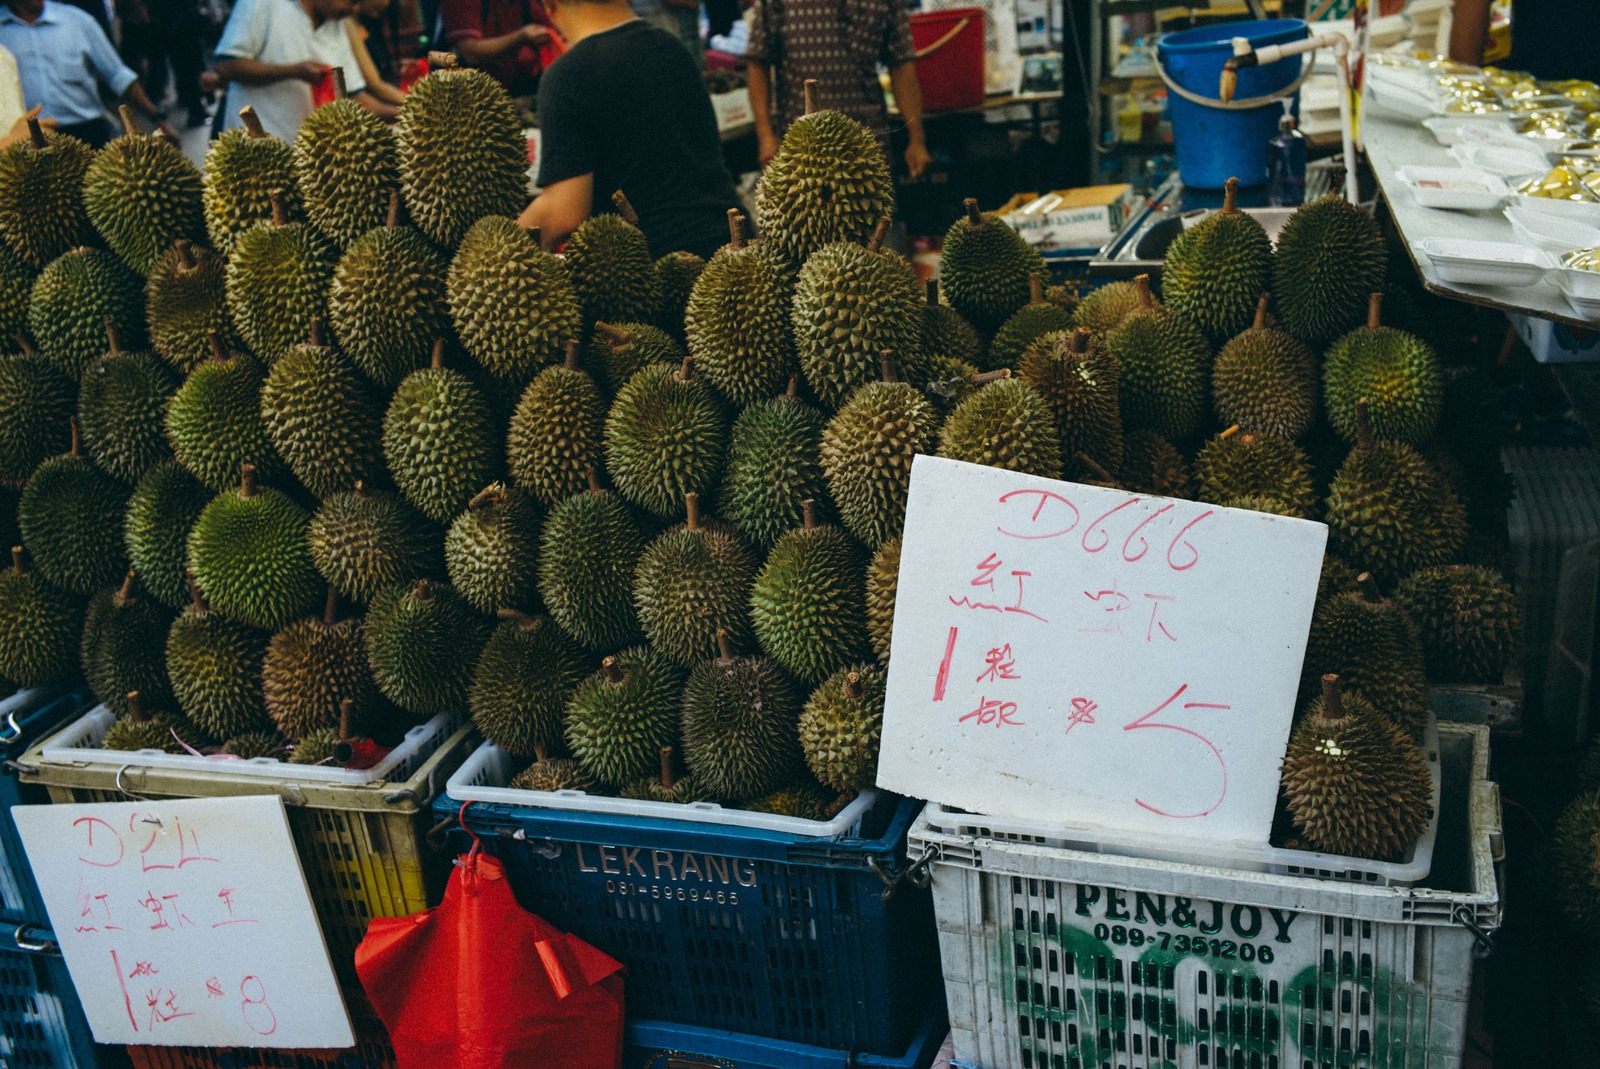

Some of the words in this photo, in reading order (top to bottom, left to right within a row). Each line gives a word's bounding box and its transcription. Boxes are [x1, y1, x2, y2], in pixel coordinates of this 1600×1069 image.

[996, 489, 1214, 571] D666
[73, 812, 221, 873] D24
[605, 879, 740, 906] 081-5969465
[1074, 883, 1301, 944] PEN&JOY
